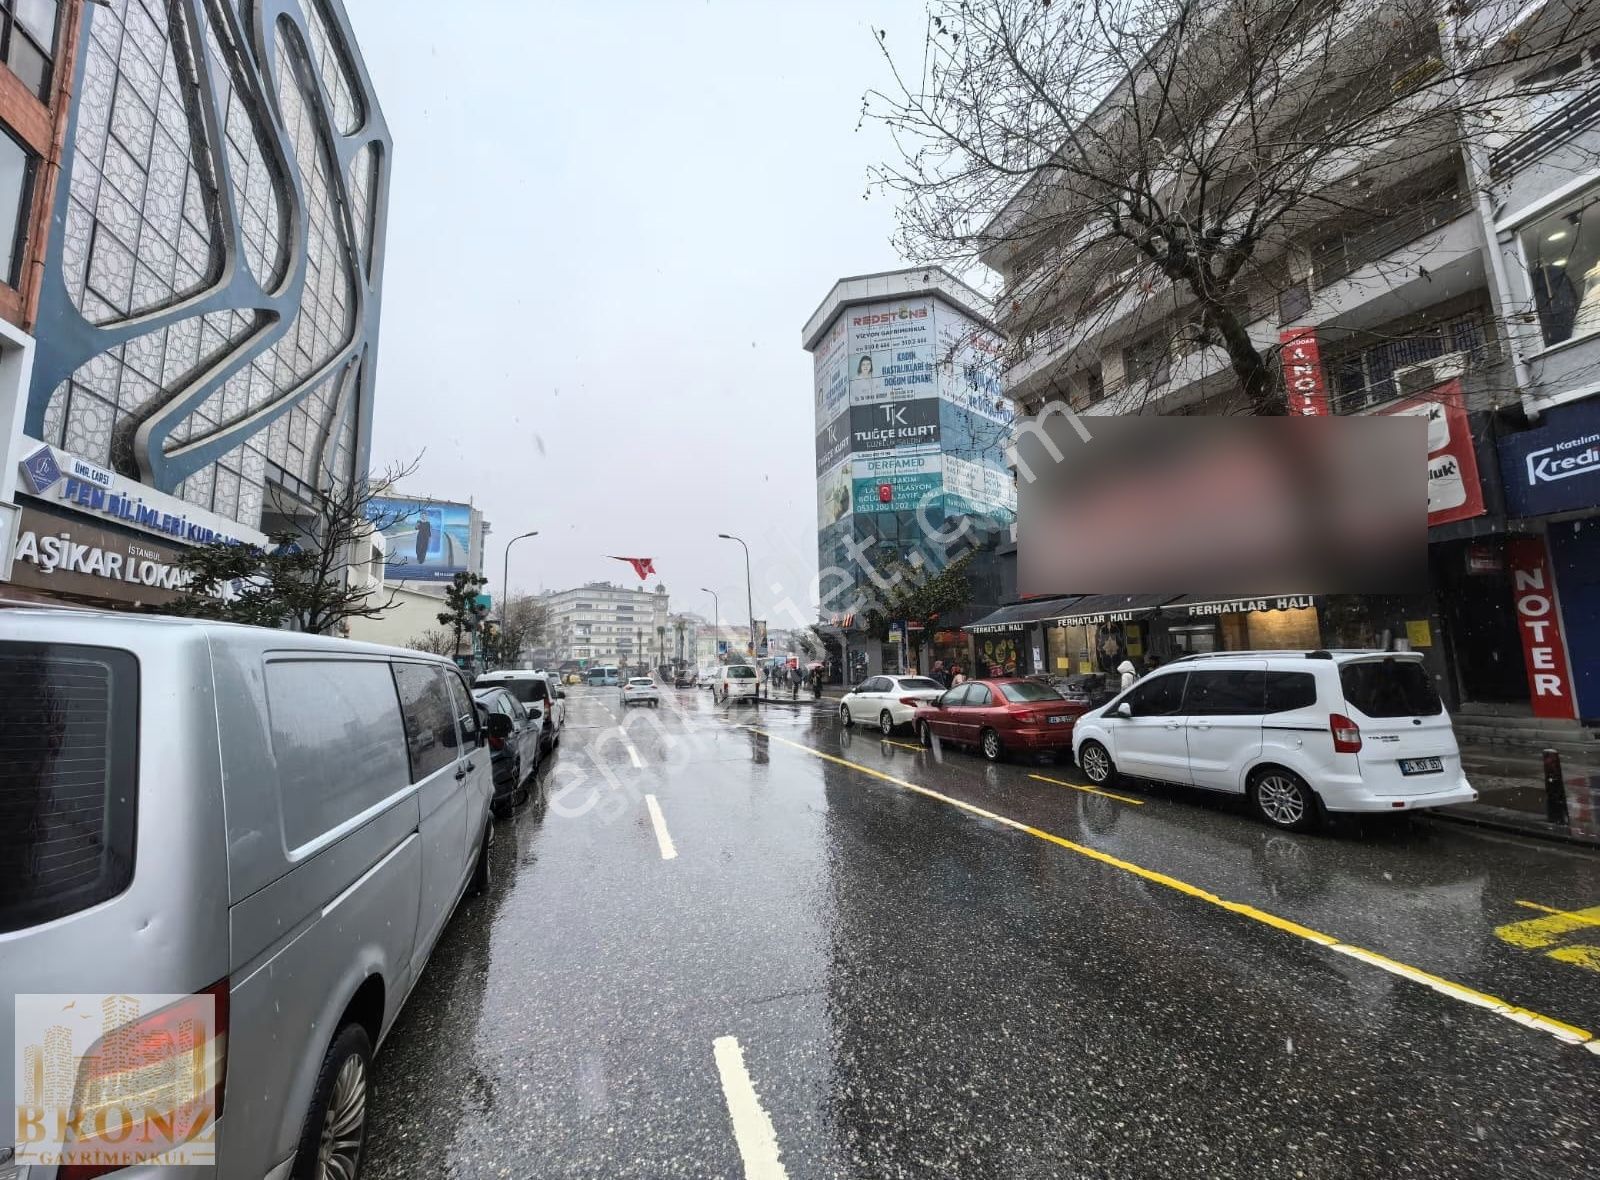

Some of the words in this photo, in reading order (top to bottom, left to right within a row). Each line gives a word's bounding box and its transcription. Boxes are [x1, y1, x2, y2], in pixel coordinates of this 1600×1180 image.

[854, 428, 896, 442] TUĞÇE
[898, 425, 937, 438] KURT
[1556, 434, 1600, 452] Katılım
[868, 459, 926, 471] DERFAMED
[64, 478, 106, 510] FEN
[108, 491, 187, 537] BİLİMLERİ
[128, 543, 160, 562] İSTANBUL
[1188, 601, 1267, 617] FERHATLAR
[1277, 595, 1314, 609] HALI
[1057, 615, 1105, 627] FERHATLAR
[1110, 612, 1132, 622] HALI
[973, 625, 1005, 634] FERHATLAR
[1514, 567, 1563, 696] NOTER
